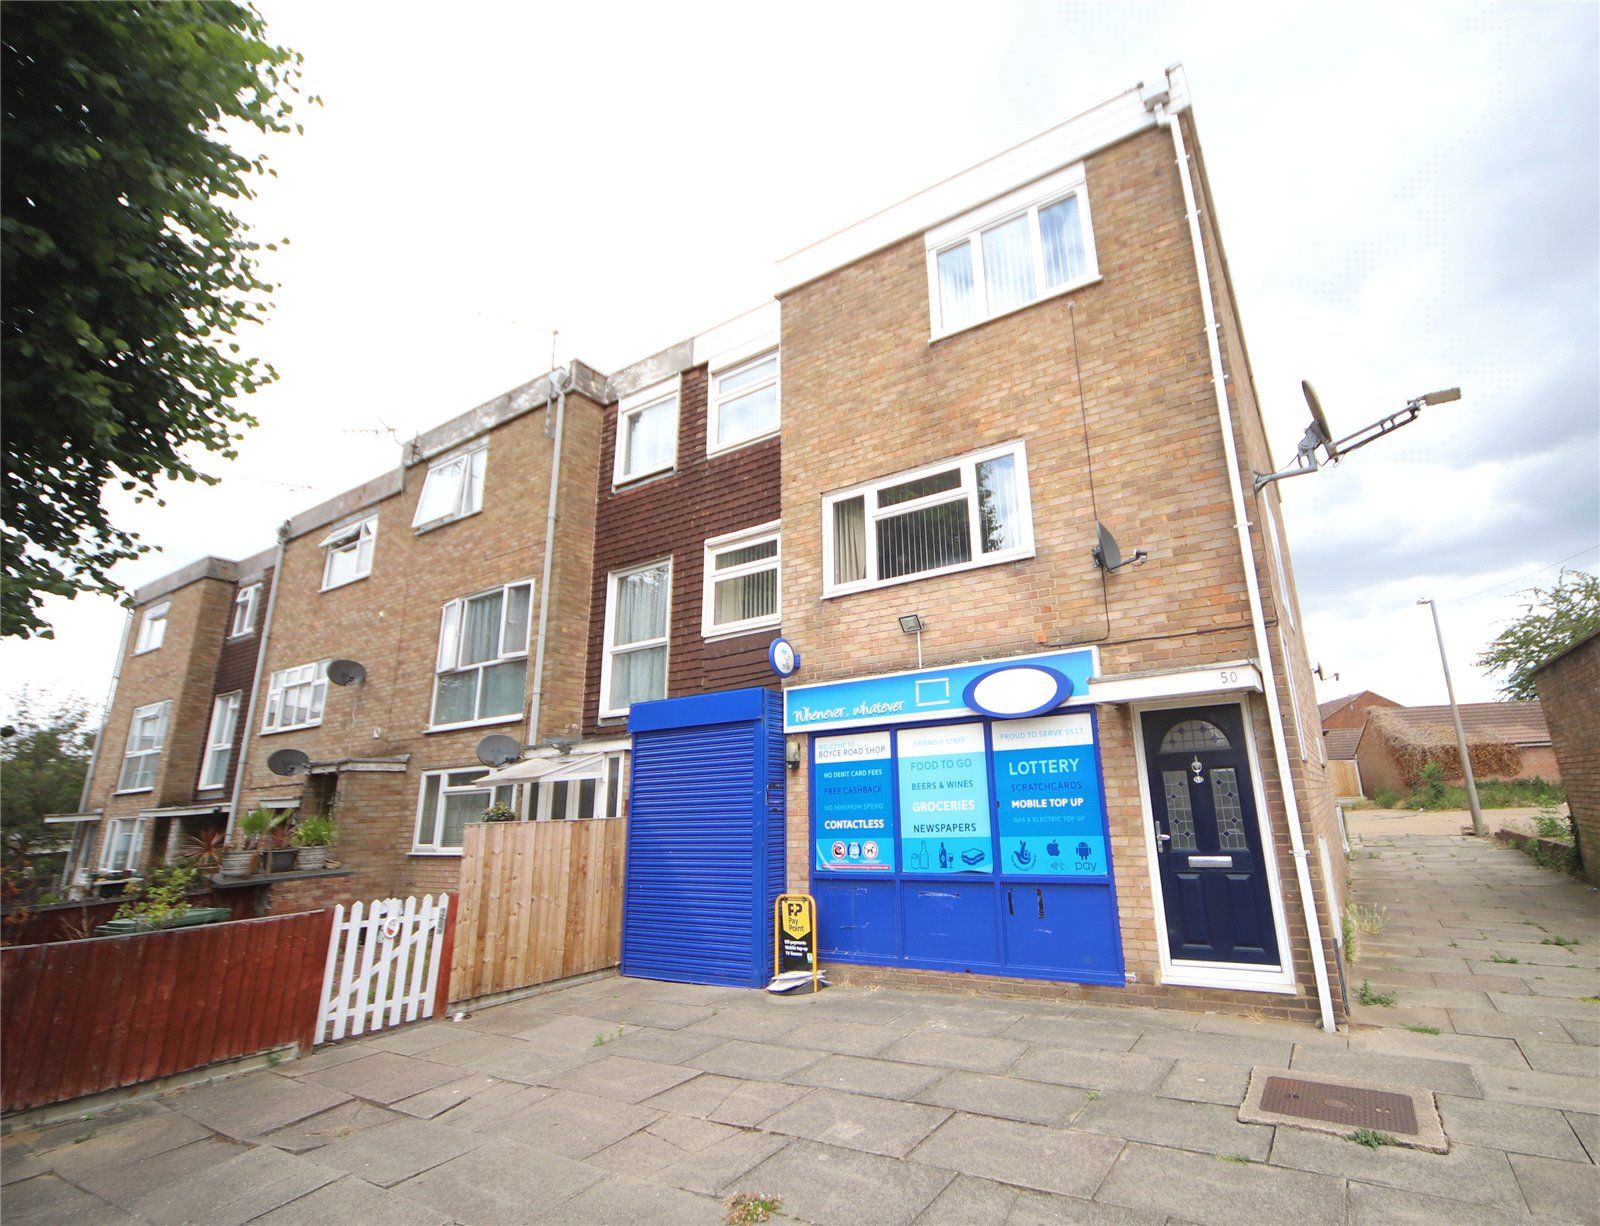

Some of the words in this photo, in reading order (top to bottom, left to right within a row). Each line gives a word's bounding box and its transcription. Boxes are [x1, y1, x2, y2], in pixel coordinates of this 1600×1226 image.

[1220, 671, 1238, 684] 50
[853, 701, 904, 715] whatever
[1000, 732, 1026, 741] PROUD
[1027, 731, 1037, 739] TO
[1038, 729, 1063, 738] SERVE
[1064, 727, 1084, 735] SS17
[817, 742, 846, 750] WELCOME
[818, 749, 842, 758] BOYCE
[843, 747, 864, 756] ROAD
[865, 745, 886, 755] SHOP
[910, 760, 938, 771] FOOD
[941, 759, 955, 769] TO
[956, 758, 972, 768] GO
[1008, 758, 1079, 775] LOTTERY
[833, 770, 850, 778] DEBIT
[850, 769, 867, 777] CARD
[867, 768, 883, 776] FEES
[824, 787, 842, 795] FREE
[843, 785, 883, 794] CASHBACK
[911, 782, 937, 791] BEERS
[938, 781, 945, 789] &
[946, 780, 974, 789] WINES
[1010, 780, 1083, 792] SCRATCHCARDS
[834, 803, 862, 811] MINIMUM
[912, 799, 975, 813] GROCERIES
[1011, 799, 1048, 809] MOBILE
[1048, 798, 1068, 807] TOP
[1070, 797, 1085, 807] UP
[824, 819, 885, 830] CONTACTLESS
[913, 822, 977, 834] NEWSPAPERS
[1075, 861, 1097, 873] pay
[788, 917, 799, 926] Pay
